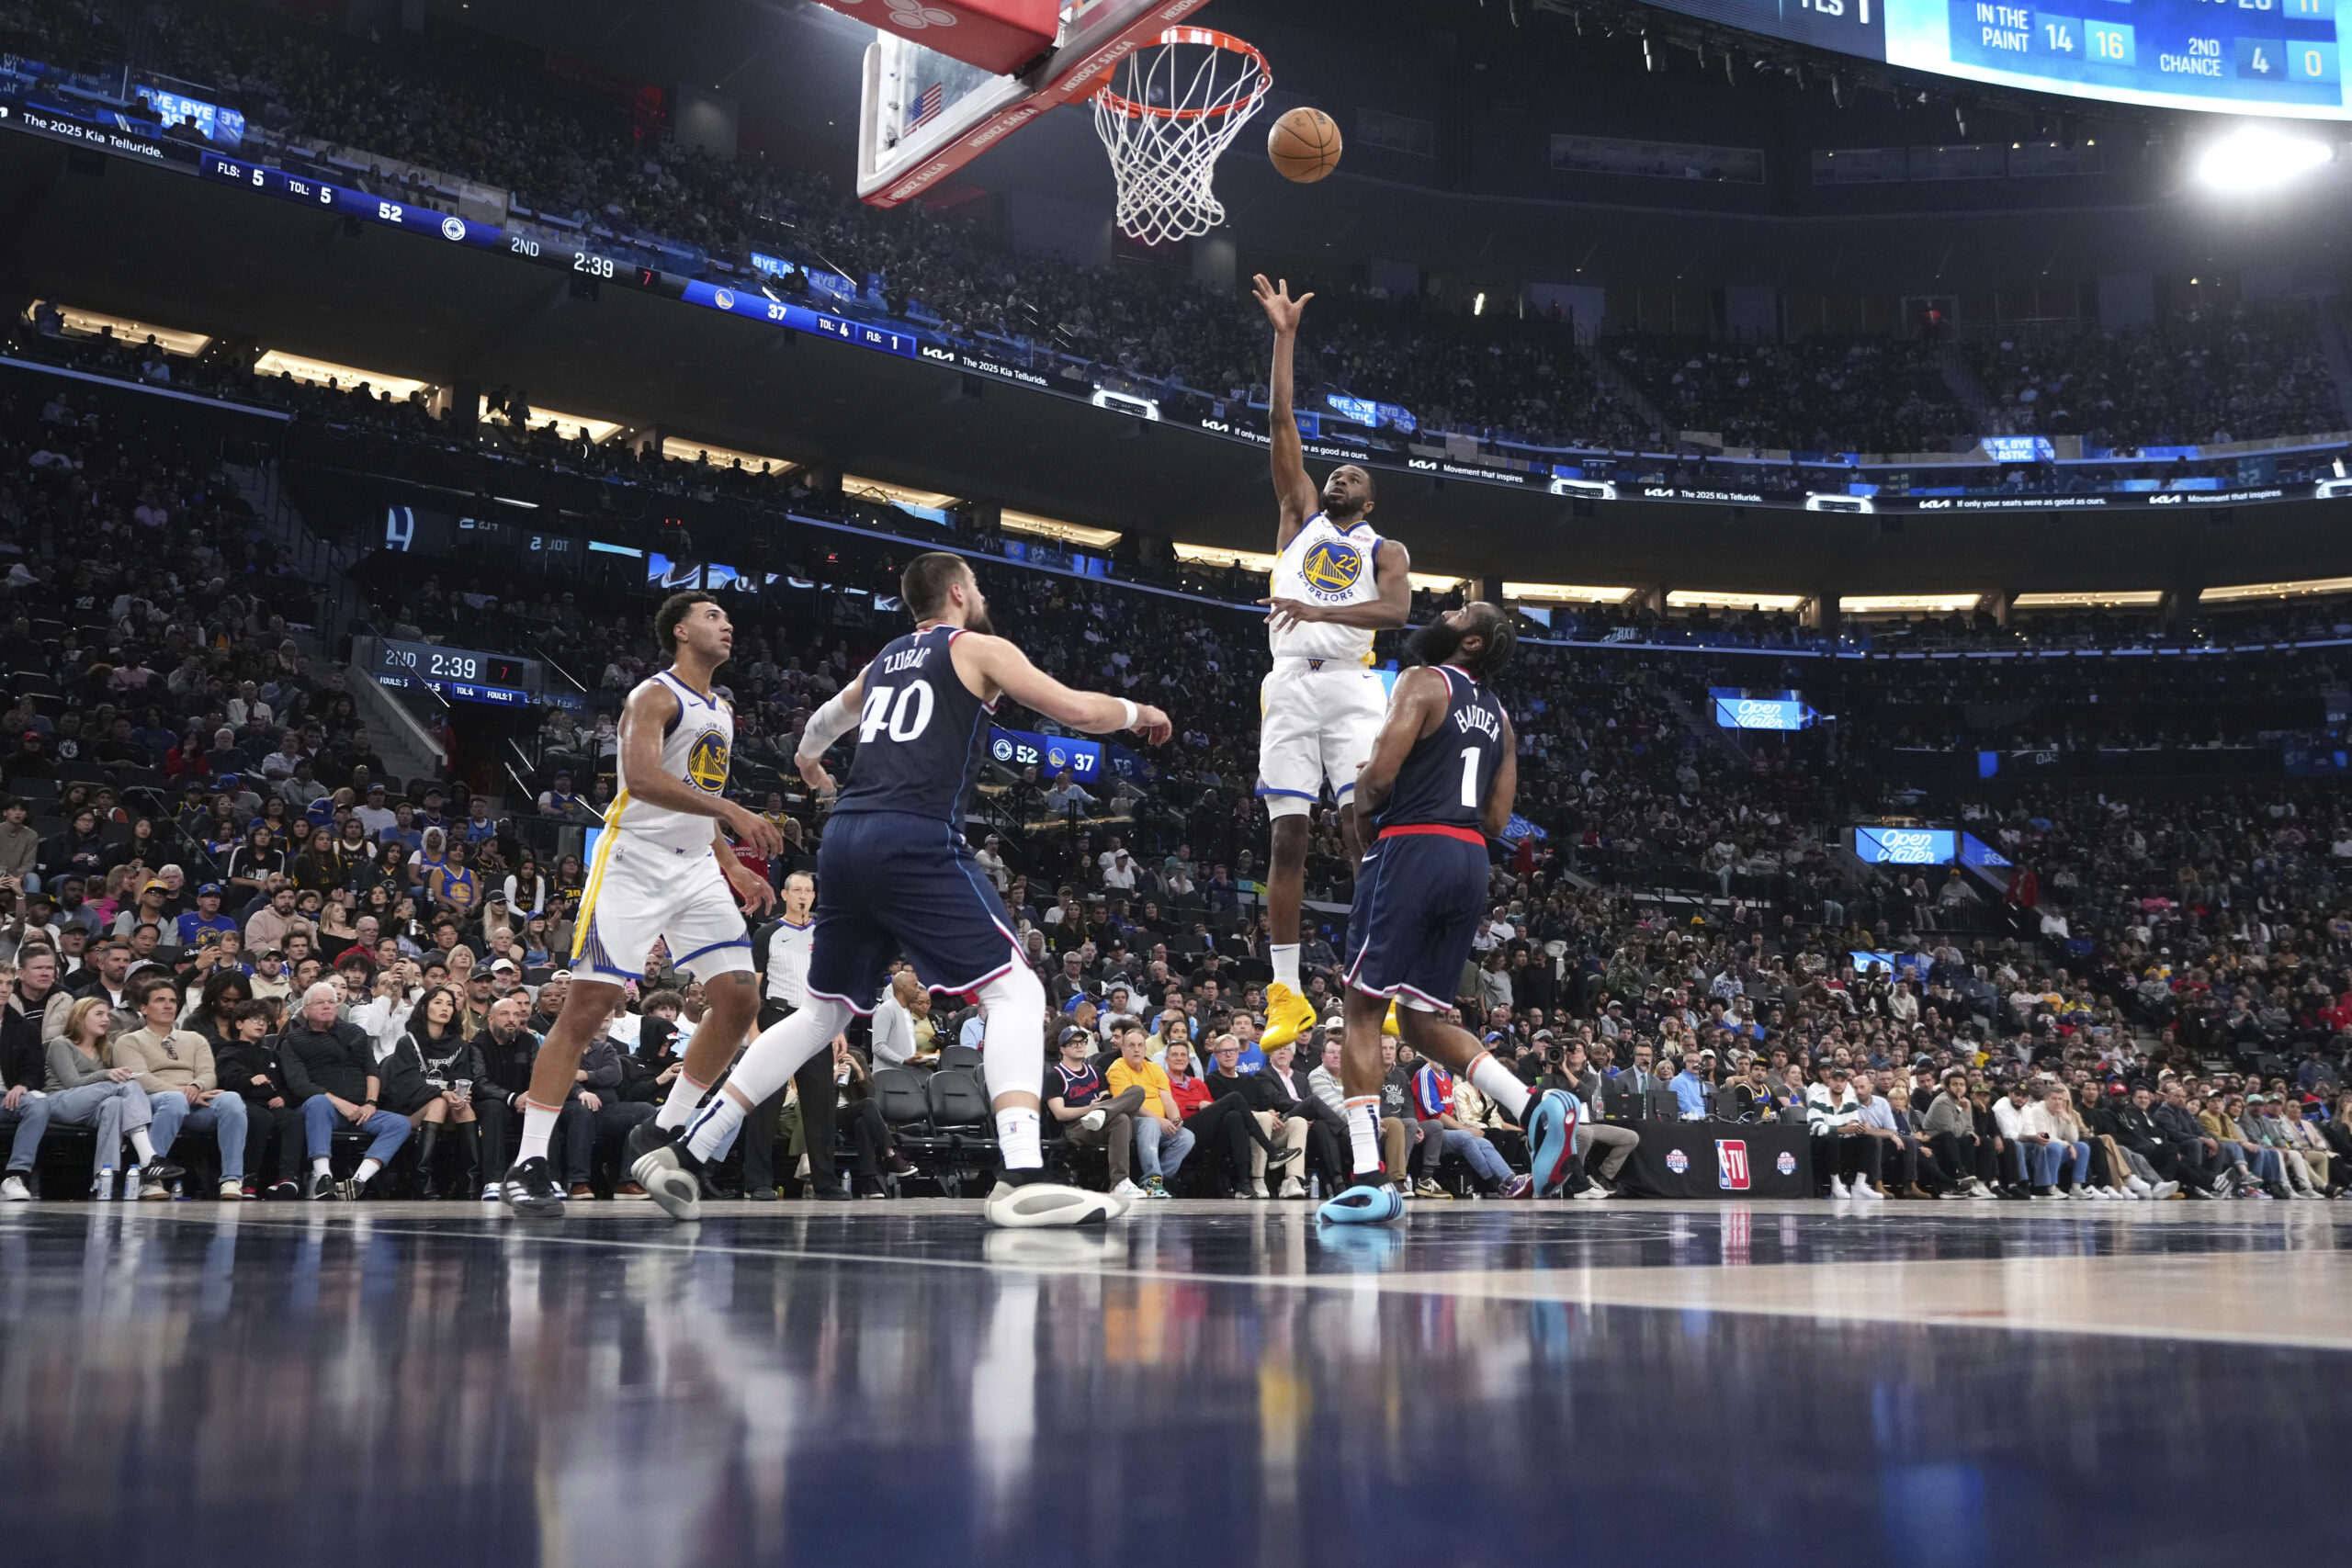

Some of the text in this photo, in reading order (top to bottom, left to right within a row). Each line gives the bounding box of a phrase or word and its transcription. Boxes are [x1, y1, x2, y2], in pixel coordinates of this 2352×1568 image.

[1976, 4, 2029, 29] IN THE
[1982, 24, 2124, 59] PAINT 14 16
[2188, 37, 2220, 56] 2ND
[1061, 40, 1136, 92] HERDEZ SALSA
[2160, 47, 2322, 76] CHANCE 4 0
[180, 100, 213, 120] BYE
[23, 112, 48, 129] The
[50, 122, 83, 138] 2025
[85, 130, 106, 143] Kia
[108, 135, 164, 159] Telluride.
[968, 108, 1039, 147] HERDEZ SALSA
[218, 162, 265, 186] FLS: 5
[888, 163, 949, 201] HERDEZ SALSA
[289, 180, 332, 204] TOL: 5
[379, 202, 402, 223] 52
[511, 237, 651, 285] 2ND 2:39 7
[767, 304, 787, 321] 37
[819, 318, 849, 337] TOL: 4
[866, 331, 898, 350] FLS: 1
[963, 356, 978, 368] The
[978, 361, 999, 374] 2025
[1000, 367, 1012, 378] Kia
[1014, 370, 1049, 387] Telluride.
[1329, 397, 1352, 412] BYE,
[1235, 427, 1241, 435] If
[1241, 430, 1255, 441] only
[1320, 446, 1339, 457] good
[1351, 451, 1369, 460] ours.
[2010, 439, 2032, 449] BYE
[1443, 464, 1479, 477] Movement
[1481, 470, 1495, 479] that
[1497, 472, 1523, 483] inspires
[1680, 490, 1695, 498] The
[1696, 491, 1714, 500] 2025
[1716, 492, 1728, 501] Kia
[1730, 493, 1762, 502] Telluride.
[1964, 500, 1982, 508] only
[2054, 498, 2075, 507] good
[2188, 493, 2230, 503] Movement
[2231, 492, 2247, 501] that
[2249, 489, 2282, 499] inspires
[1336, 554, 1358, 571] 22
[1296, 570, 1353, 602] WARRIORS
[386, 649, 508, 680] 2ND 2:39 7
[859, 679, 933, 743] 40
[1738, 700, 1781, 715] Open
[695, 723, 717, 738] GOLDEN
[1735, 714, 1783, 728] Water
[715, 746, 727, 765] 32
[1016, 746, 1094, 772] 52 37
[1461, 747, 1481, 807] 1
[1882, 829, 1932, 847] Open
[1877, 846, 1935, 863] Water
[1728, 1149, 1745, 1179] TV
